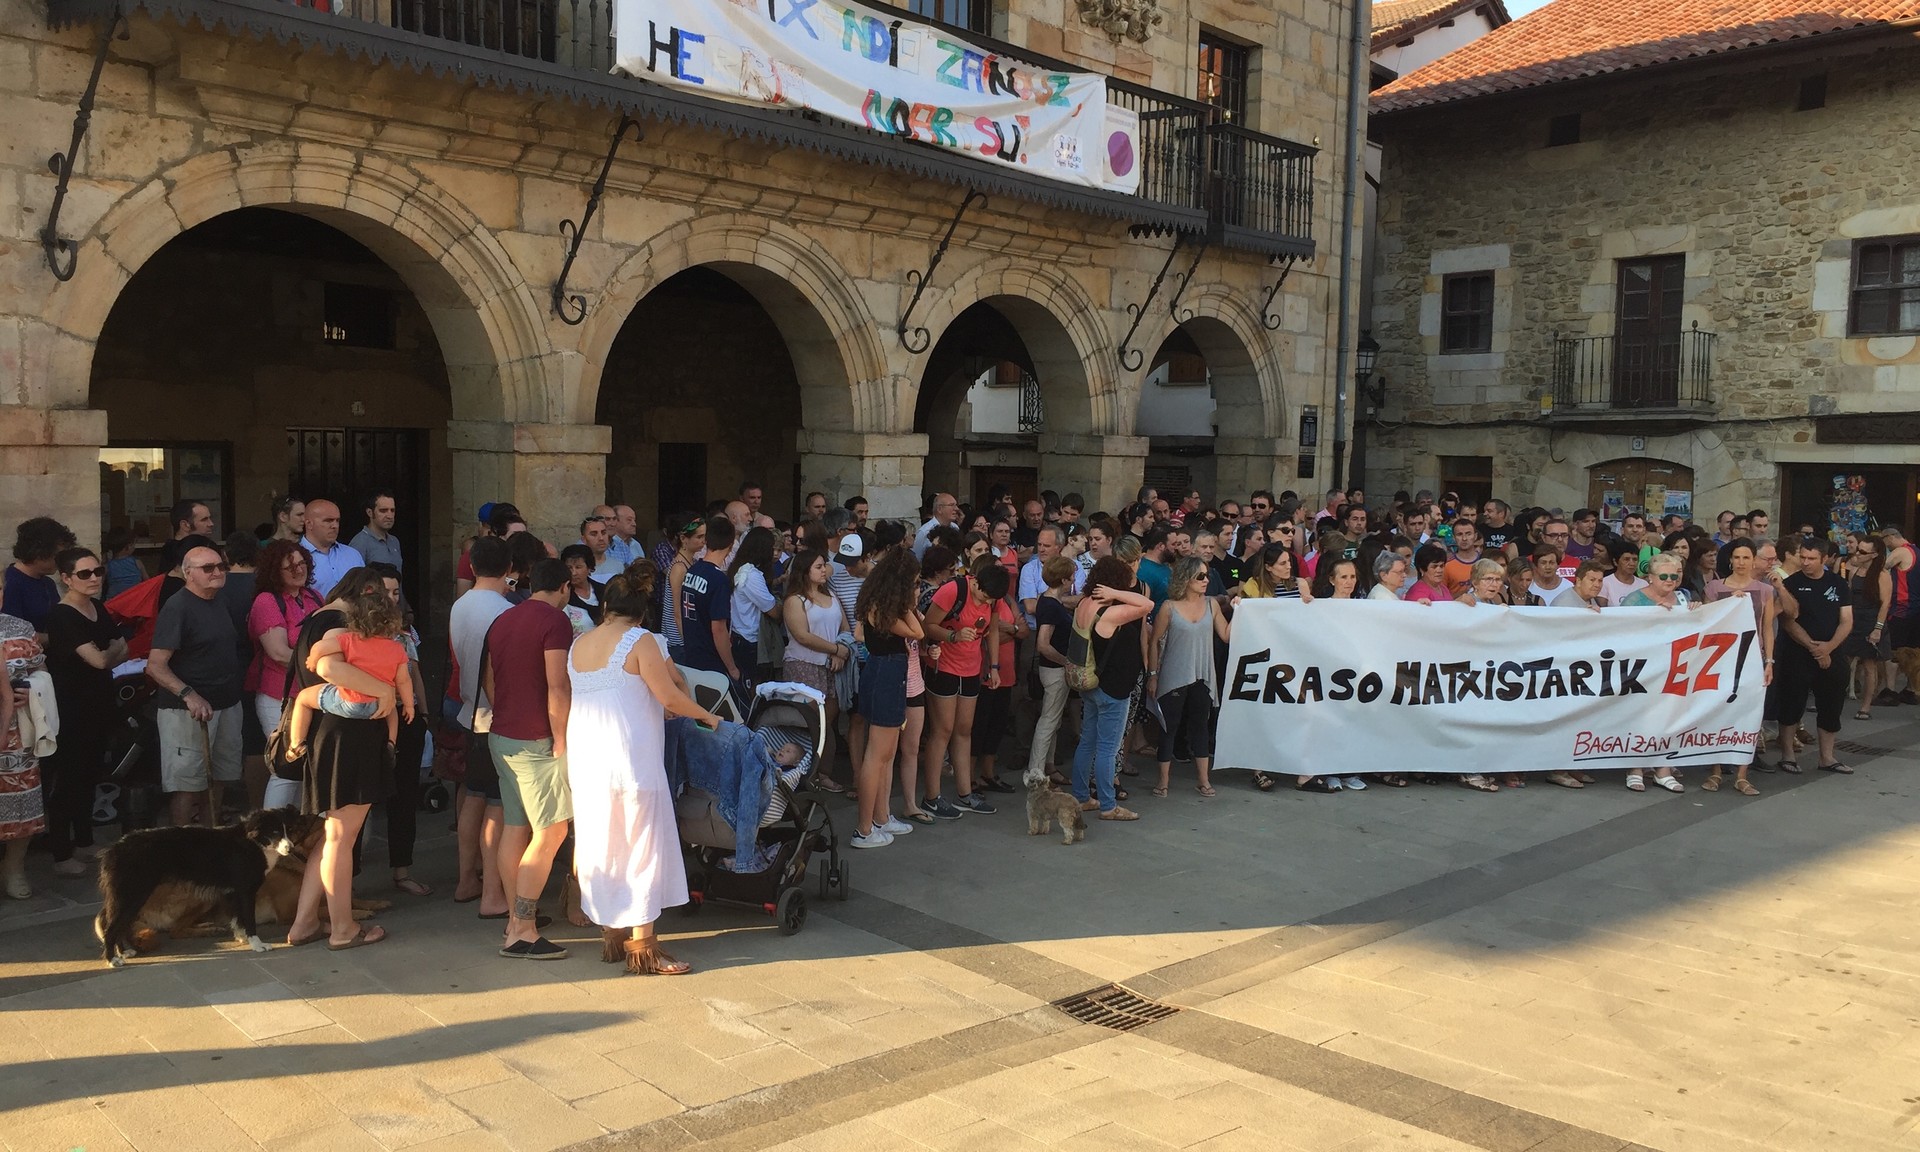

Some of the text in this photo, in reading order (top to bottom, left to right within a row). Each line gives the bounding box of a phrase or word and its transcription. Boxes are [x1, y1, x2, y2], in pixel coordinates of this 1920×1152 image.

[681, 572, 708, 594] ELAND
[1229, 630, 1756, 705] ERASO MATXISTARIK EZ!
[1573, 731, 1671, 757] BAGAIZAN
[1677, 727, 1716, 748] TALDE
